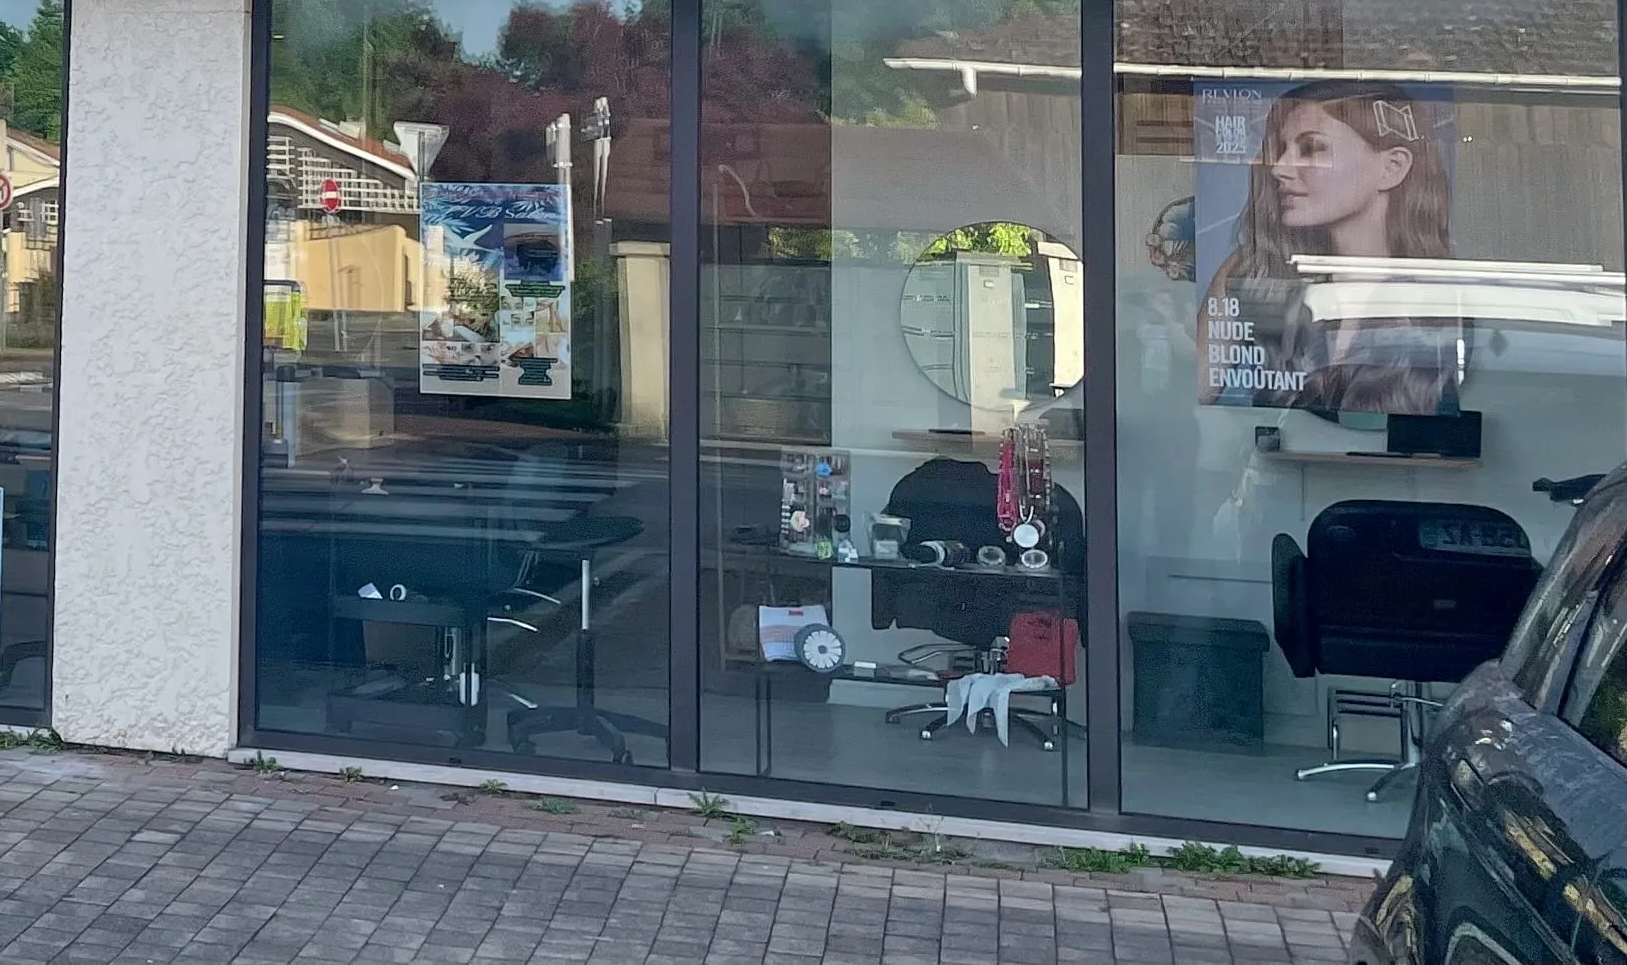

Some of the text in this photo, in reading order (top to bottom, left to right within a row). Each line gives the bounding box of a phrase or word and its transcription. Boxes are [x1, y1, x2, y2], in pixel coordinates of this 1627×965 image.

[1215, 115, 1246, 130] HAIR
[1207, 297, 1240, 317] 8.18
[1208, 321, 1255, 342] NUDE
[1208, 344, 1265, 366] BLOND
[1209, 366, 1308, 392] ENVOÛTANT
